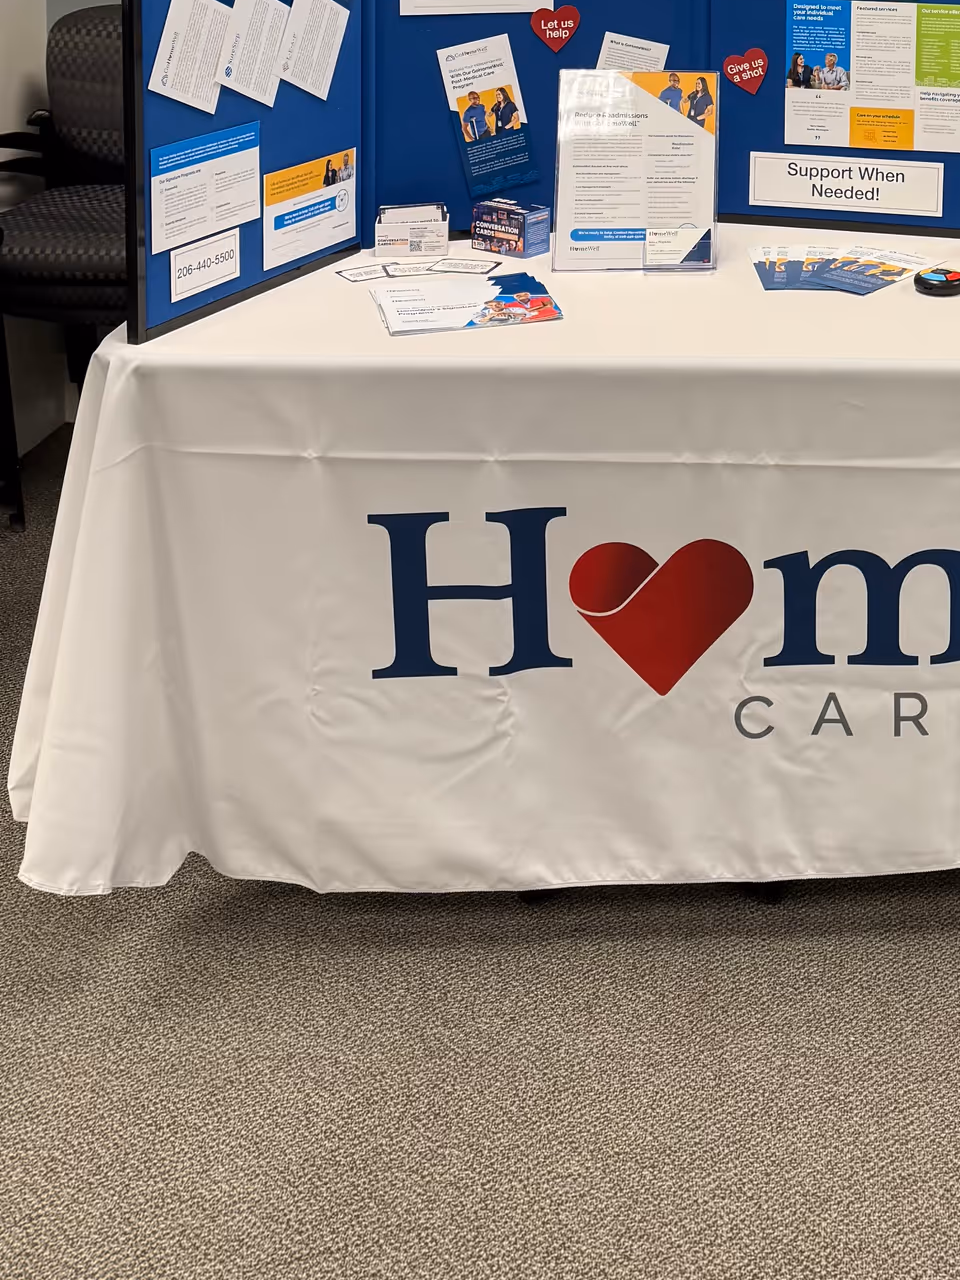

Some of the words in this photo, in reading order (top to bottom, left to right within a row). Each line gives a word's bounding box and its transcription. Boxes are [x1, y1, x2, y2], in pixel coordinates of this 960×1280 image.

[541, 20, 558, 30] Let
[560, 20, 574, 28] us
[546, 28, 570, 40] help
[728, 62, 749, 75] Give
[751, 58, 764, 68] us
[742, 66, 764, 80] shot
[786, 162, 854, 181] Support
[858, 166, 906, 183] When
[811, 184, 880, 201] Needed!
[476, 220, 519, 235] CONVERSATION
[476, 228, 495, 236] CARDS
[178, 248, 235, 280] 206-440-5500
